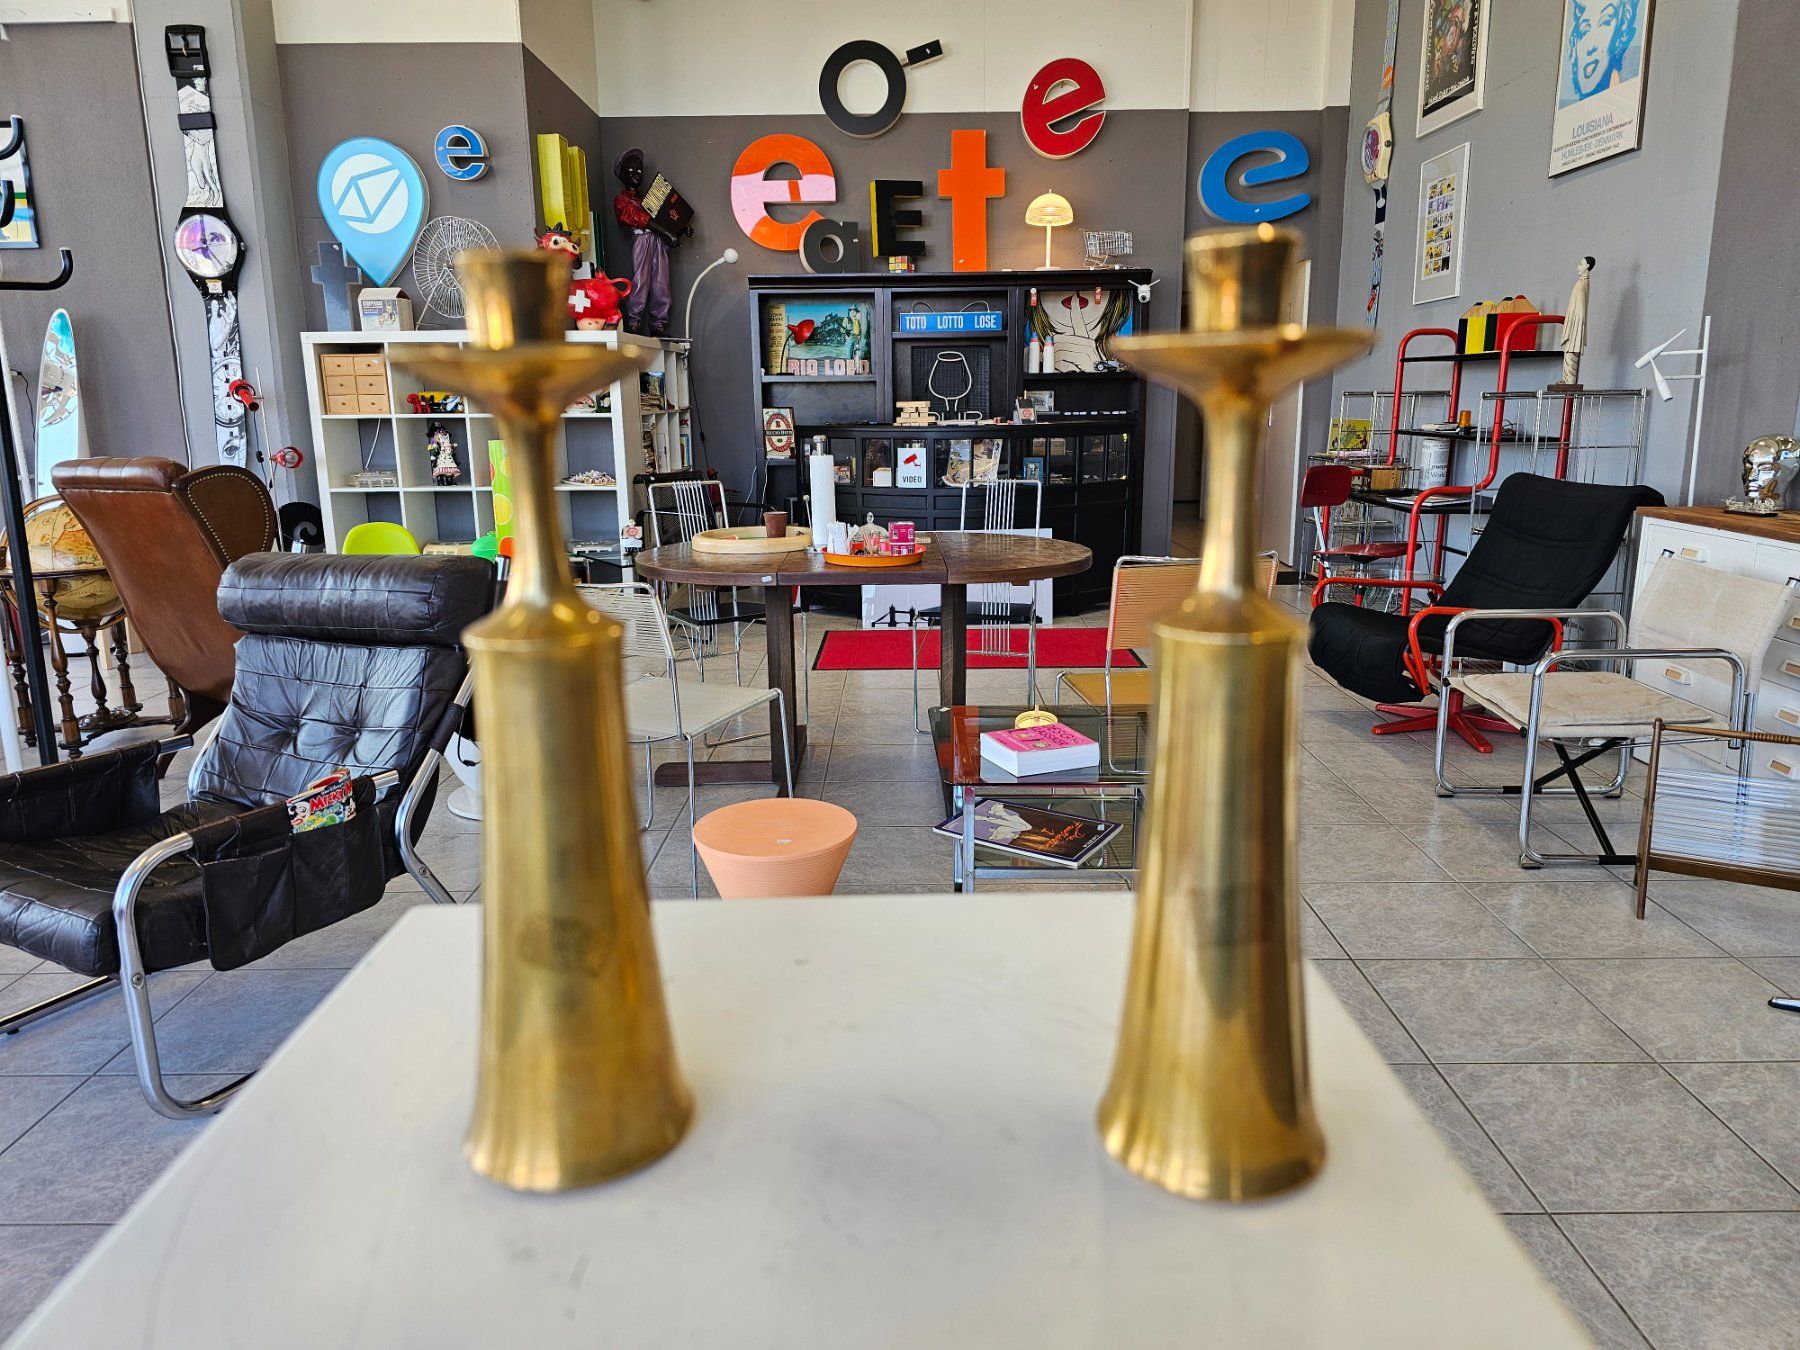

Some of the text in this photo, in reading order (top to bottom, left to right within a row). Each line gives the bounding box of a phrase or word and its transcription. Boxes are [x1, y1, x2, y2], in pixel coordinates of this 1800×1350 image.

[1572, 113, 1614, 139] LOUISIANA
[1595, 130, 1624, 148] DENMARK
[434, 125, 490, 181] e
[1197, 130, 1311, 223] e
[869, 180, 927, 257] E
[905, 315, 997, 330] TOTO LOTTO LOSE
[787, 359, 818, 375] RIO
[902, 475, 923, 484] VIDEO
